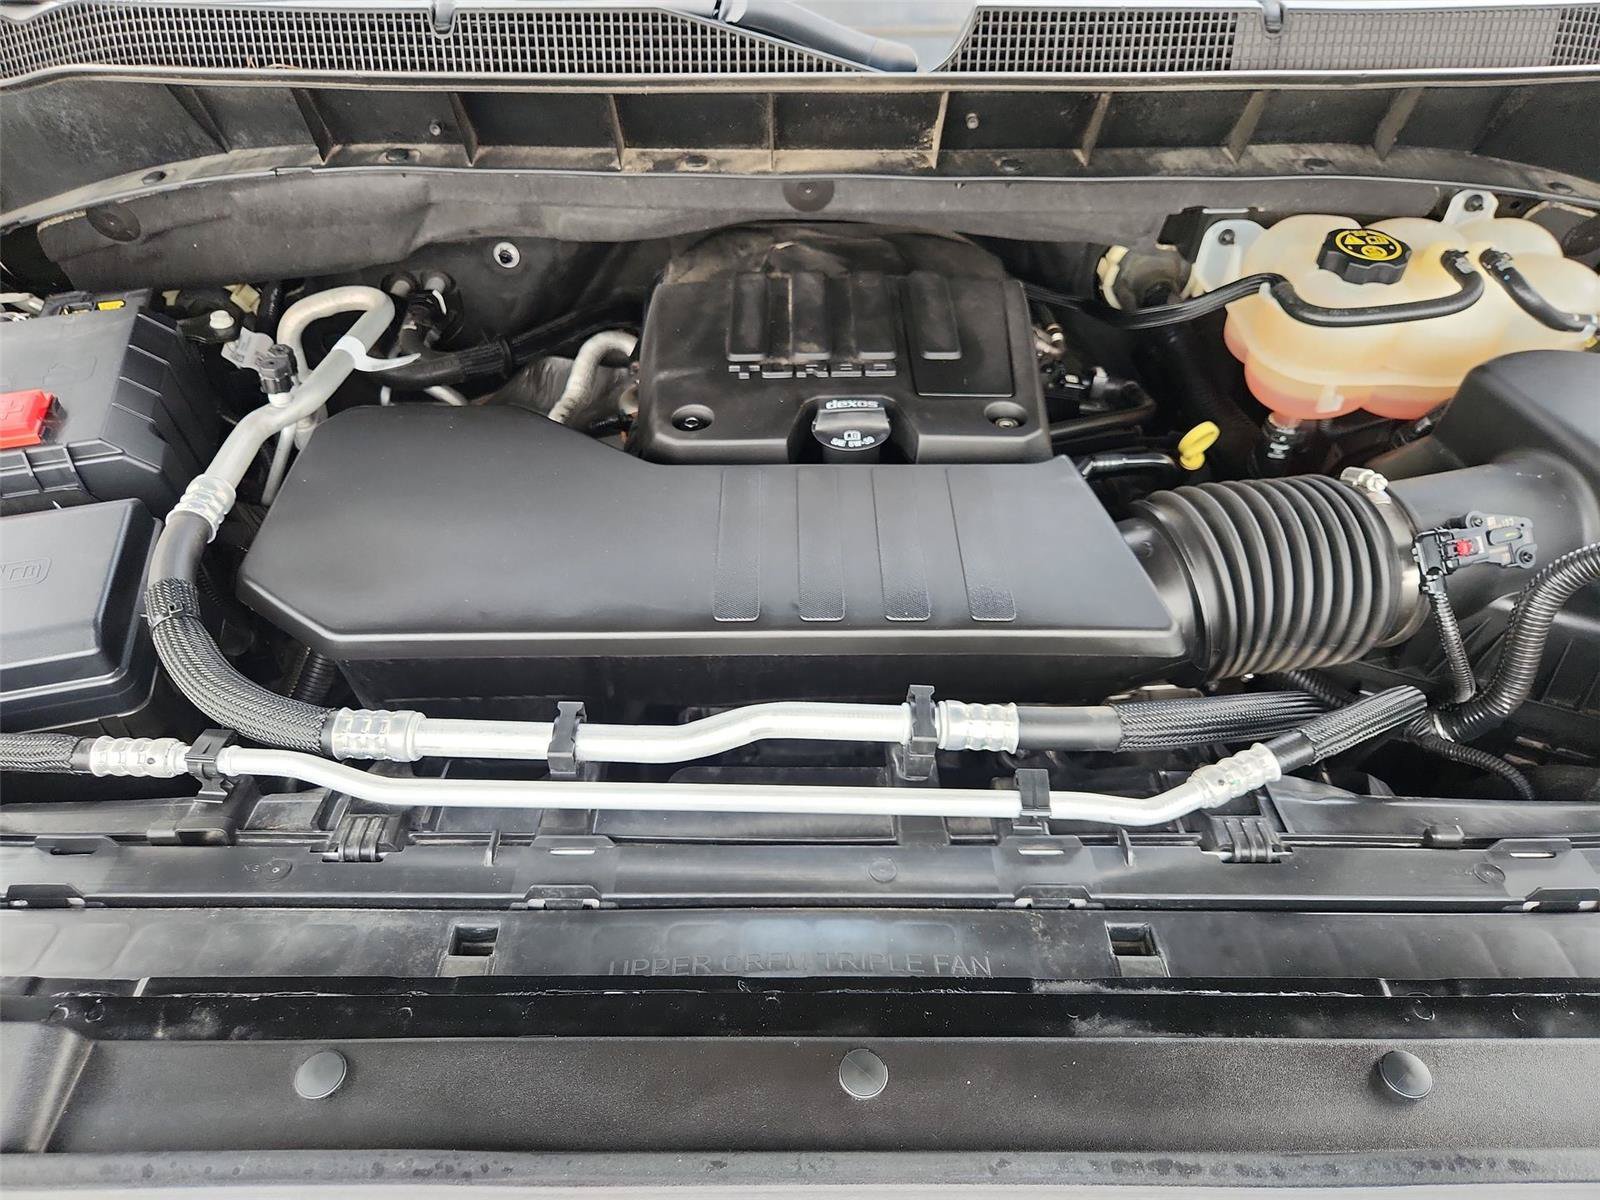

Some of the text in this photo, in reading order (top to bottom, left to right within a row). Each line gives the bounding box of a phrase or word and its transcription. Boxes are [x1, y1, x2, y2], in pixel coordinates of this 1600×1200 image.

[728, 364, 897, 380] TURBO
[825, 399, 879, 410] dexos
[608, 954, 713, 977] UPPER
[816, 951, 926, 975] TRIPLE
[932, 952, 994, 979] FAN
